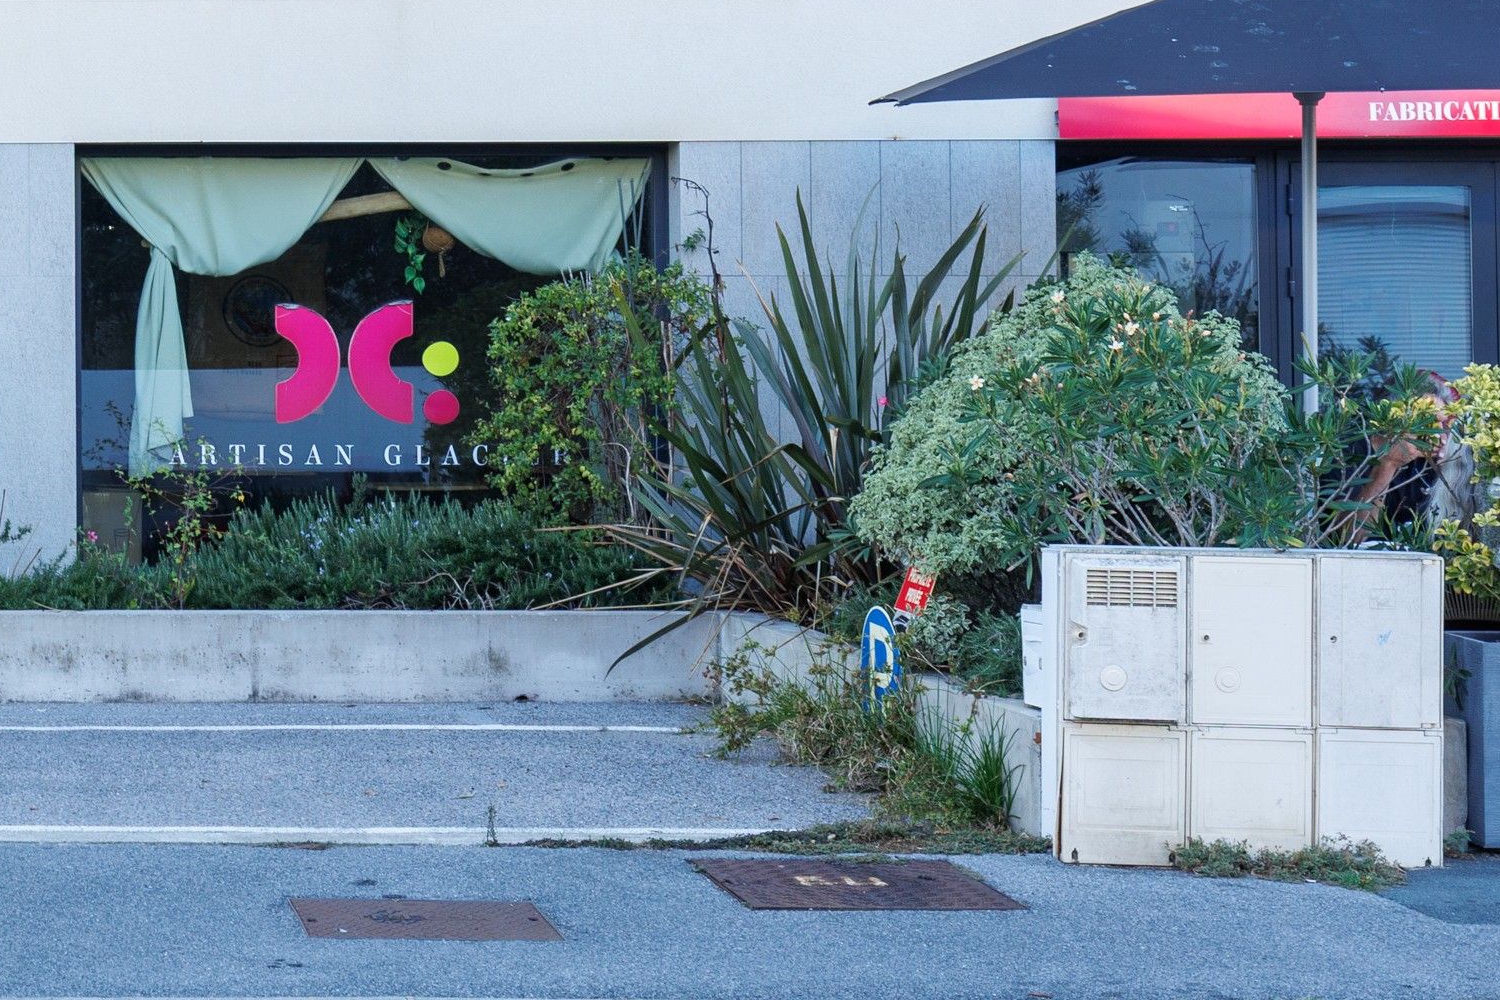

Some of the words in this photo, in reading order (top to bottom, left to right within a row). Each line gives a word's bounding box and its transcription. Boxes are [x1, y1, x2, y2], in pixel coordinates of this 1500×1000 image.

[168, 443, 355, 466] ARTISAN
[383, 443, 571, 466] GLACR
[869, 621, 894, 700] P
